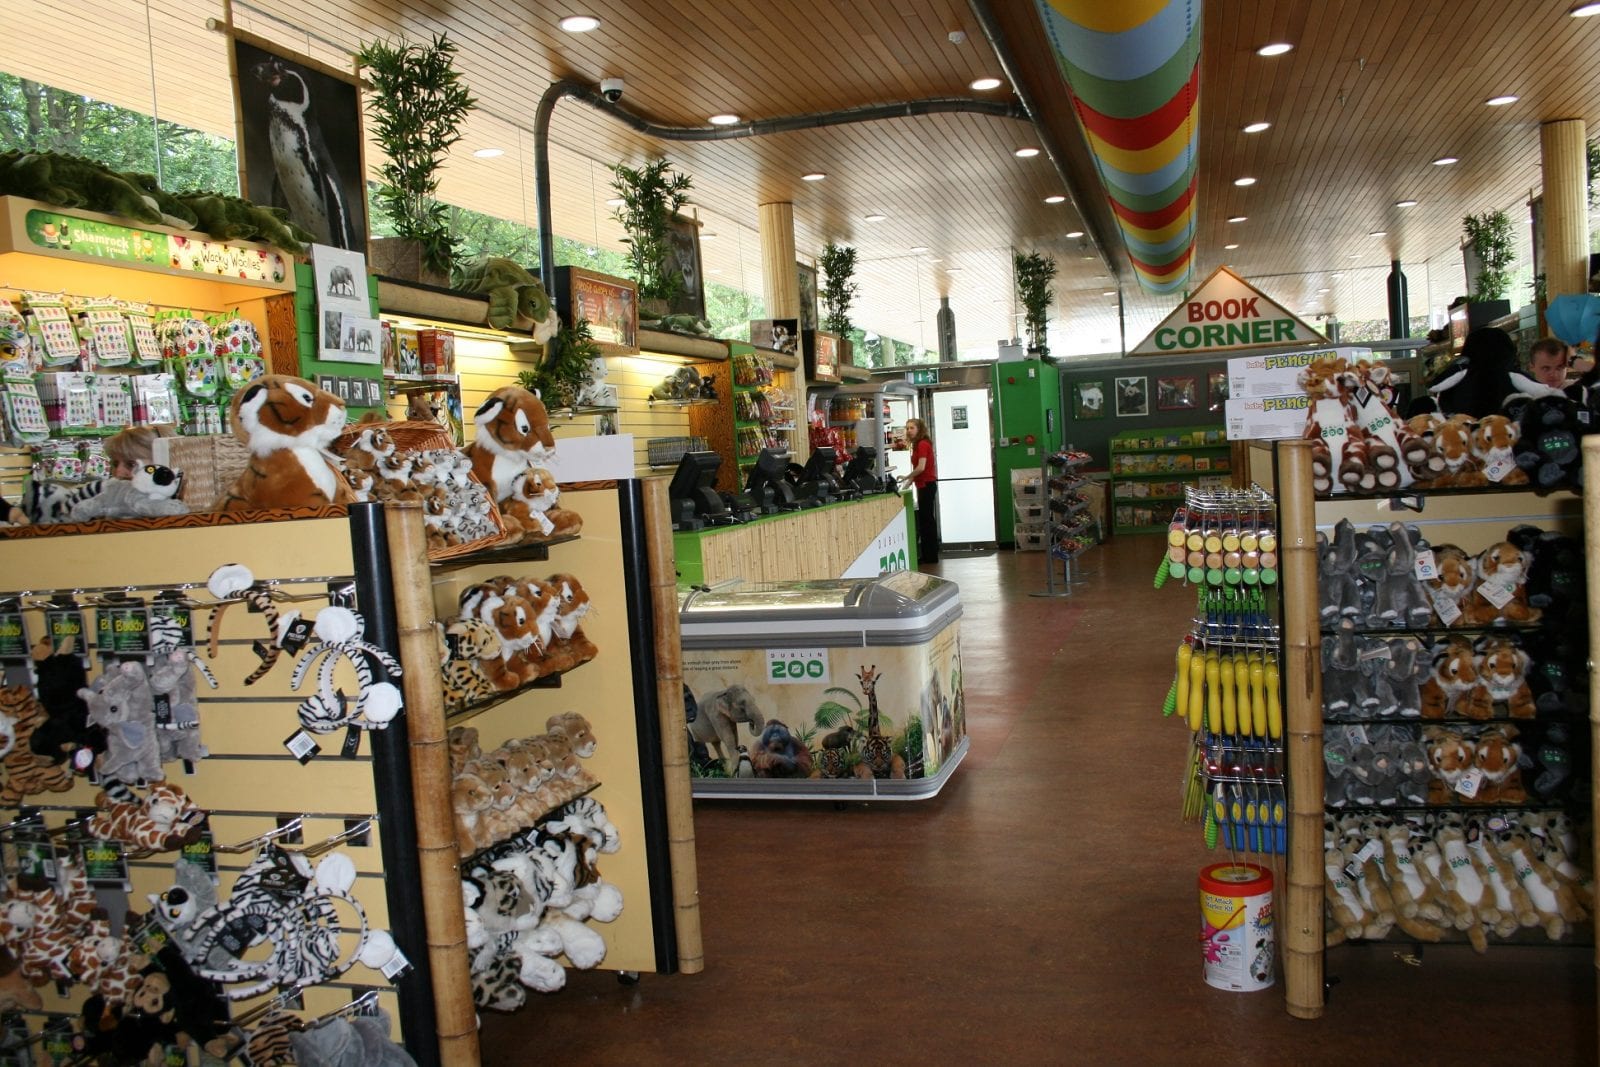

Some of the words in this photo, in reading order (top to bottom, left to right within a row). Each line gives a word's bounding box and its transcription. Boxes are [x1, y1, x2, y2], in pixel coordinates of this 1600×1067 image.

[73, 229, 129, 249] Shamrock
[200, 250, 229, 270] Wacky
[1187, 296, 1260, 323] BOOK
[1154, 319, 1297, 351] CORNER
[54, 623, 80, 635] Buddy
[115, 619, 145, 632] Buddy
[771, 660, 824, 678] ZOO
